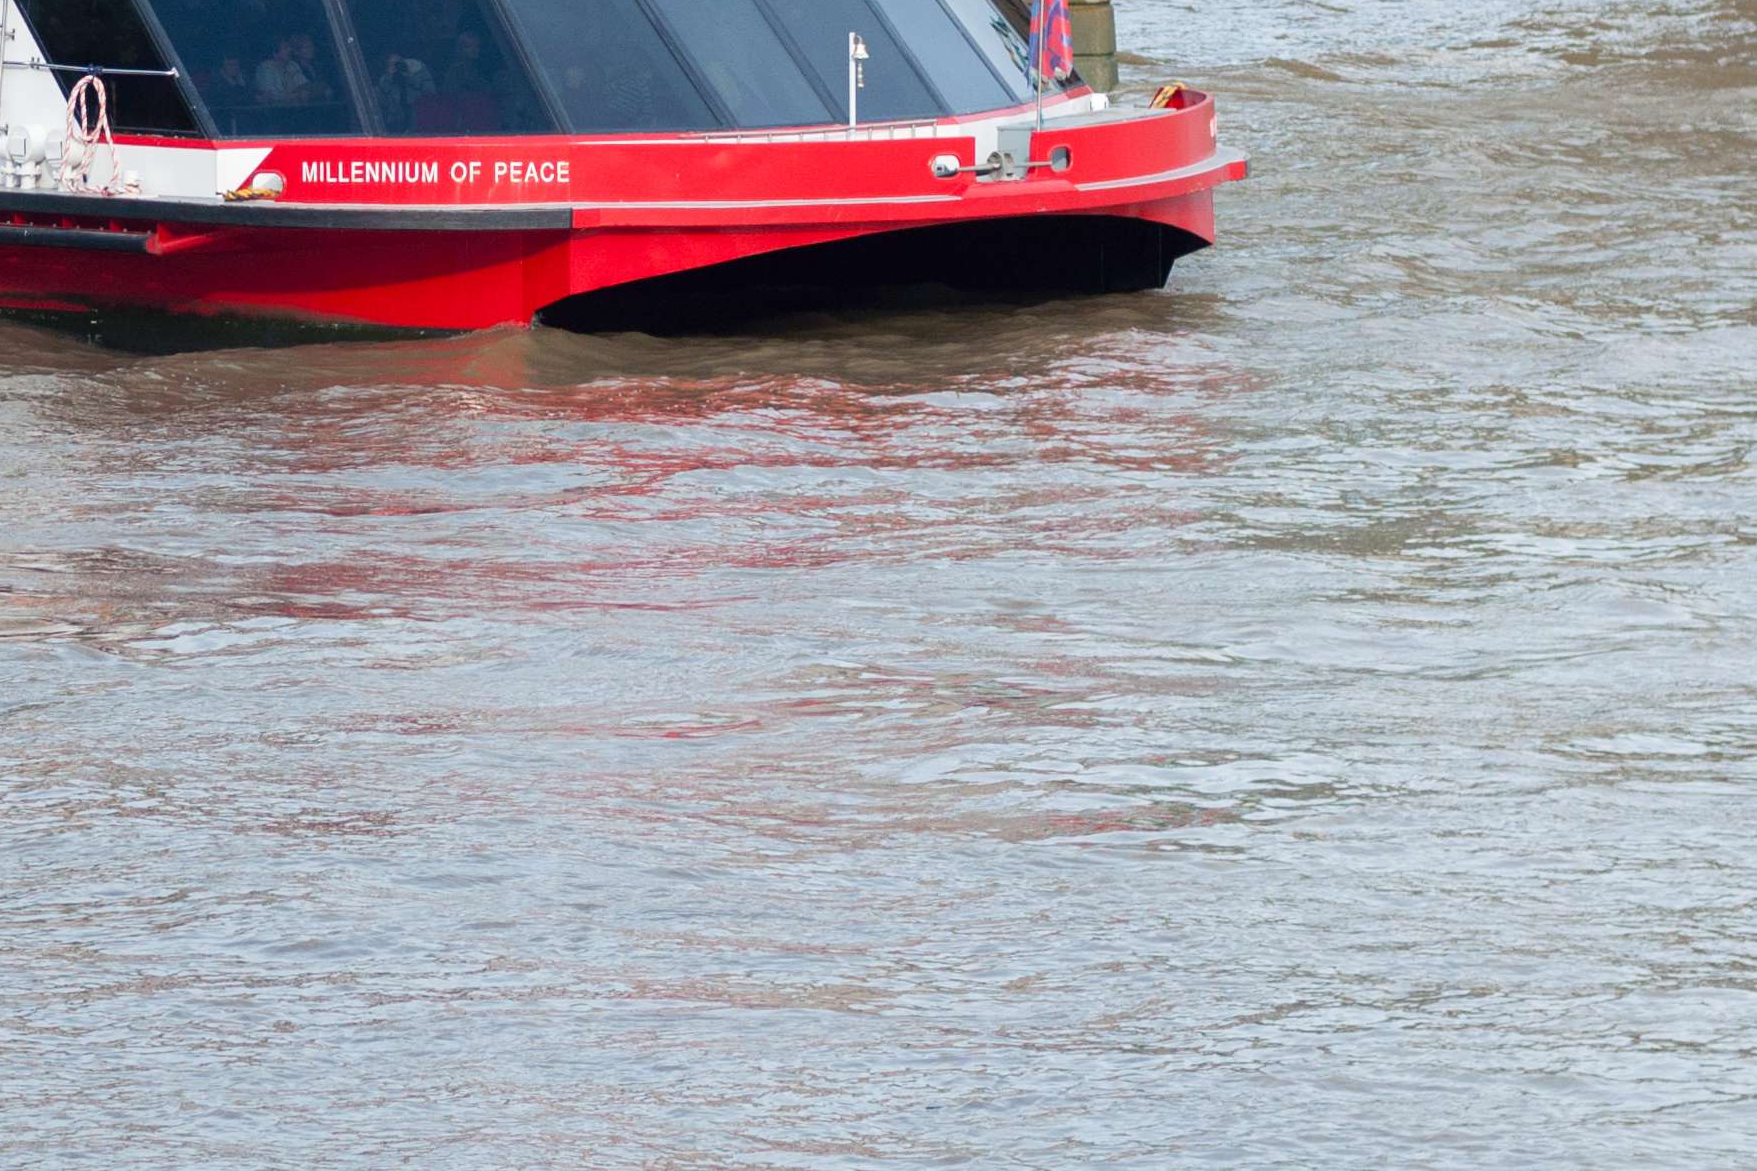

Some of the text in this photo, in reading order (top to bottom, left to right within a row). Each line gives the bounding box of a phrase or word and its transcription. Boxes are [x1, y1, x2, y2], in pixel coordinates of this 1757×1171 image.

[301, 161, 570, 183] MILLENNIUM OF PEACE
